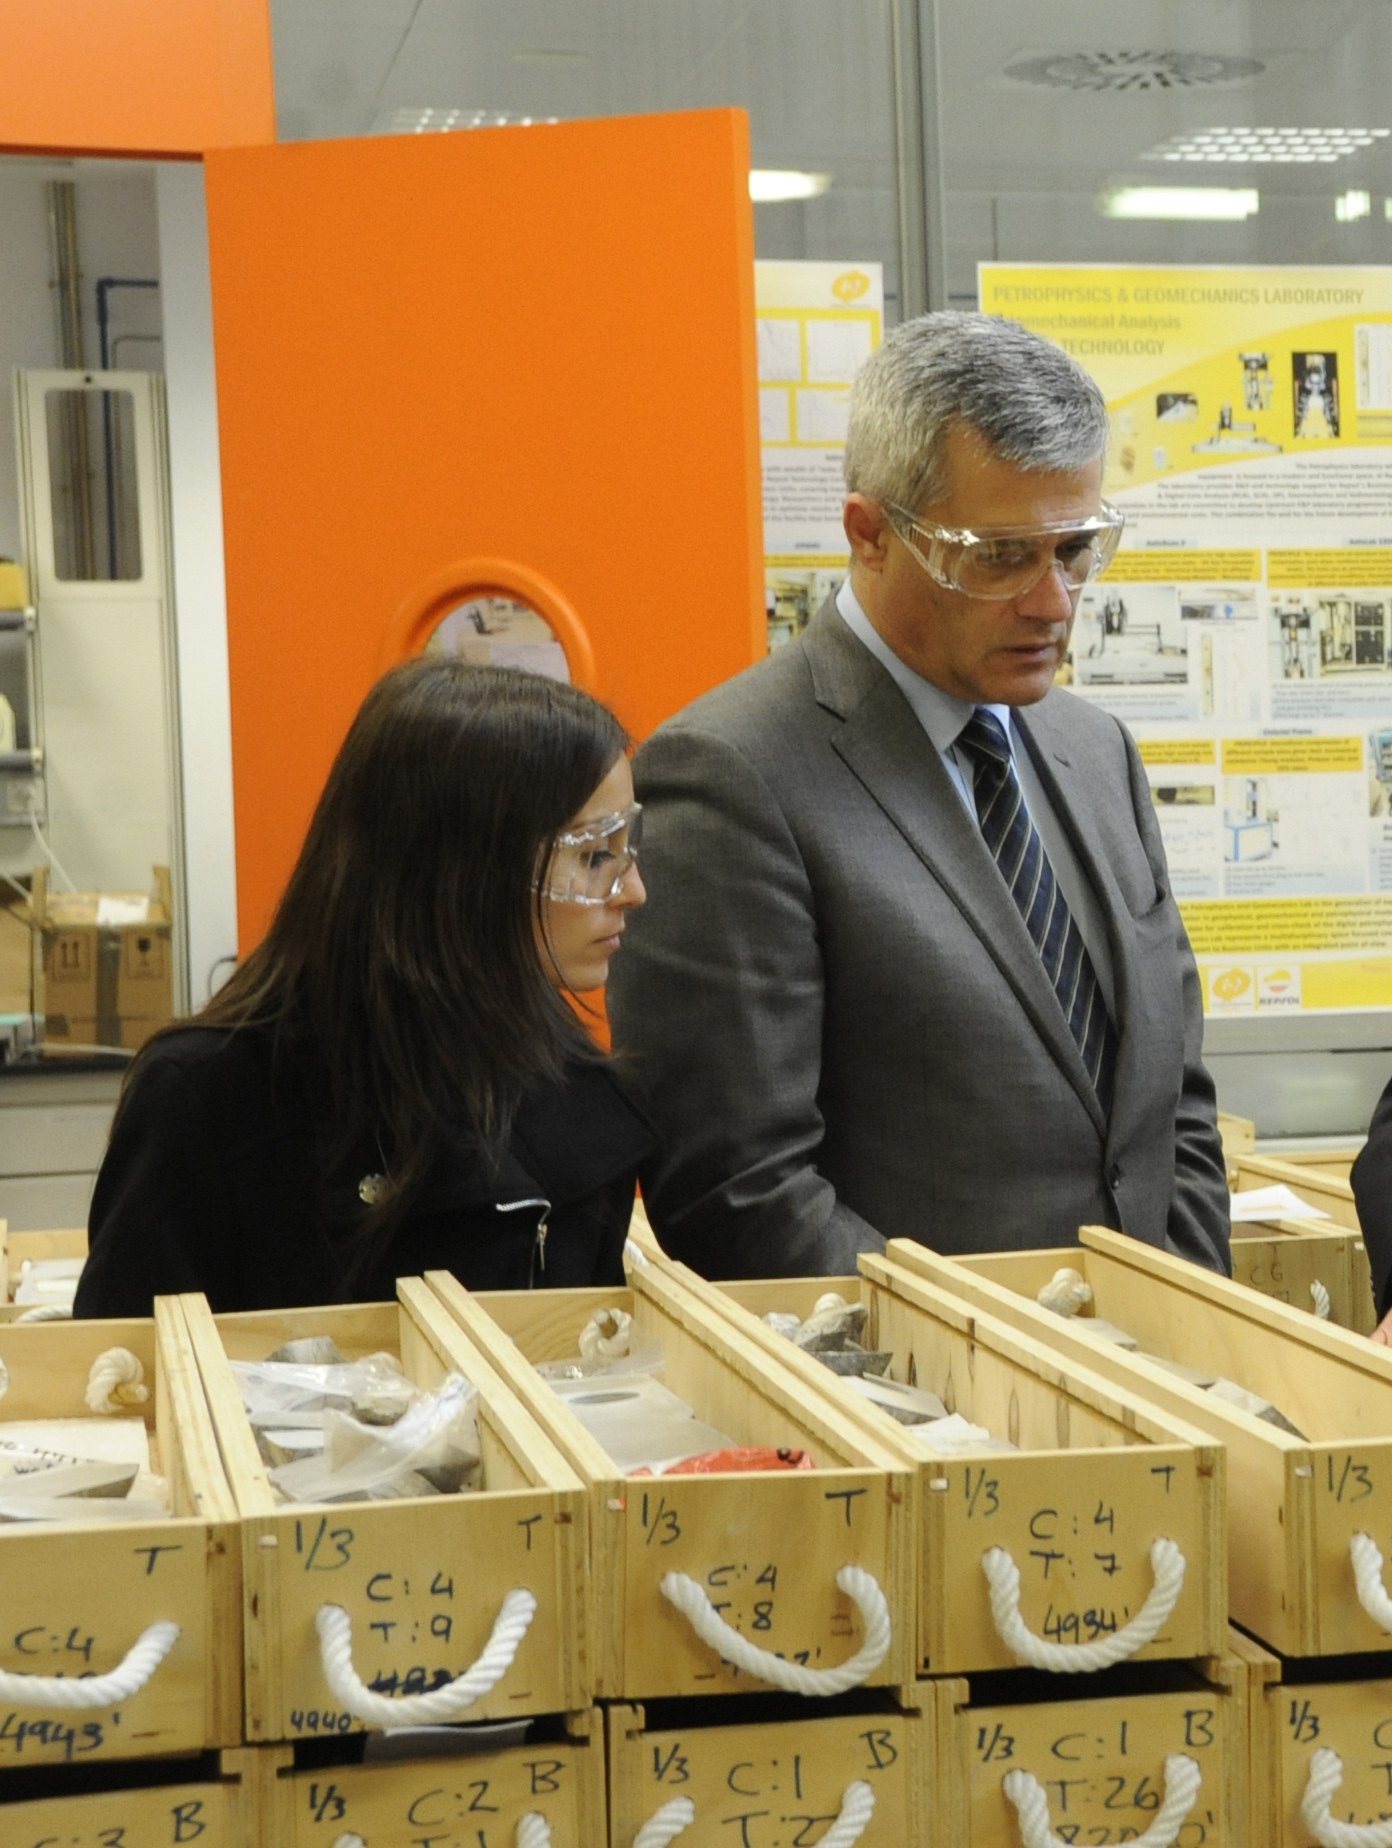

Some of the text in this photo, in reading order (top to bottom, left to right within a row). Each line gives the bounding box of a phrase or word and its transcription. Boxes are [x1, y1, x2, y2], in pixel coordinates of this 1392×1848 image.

[994, 286, 1364, 305] PETROPHYSICS & GEOMECHANICS LABORATORY
[996, 313, 1181, 331] mechanical Analysis
[1062, 339, 1164, 356] TECHNOLOGY
[964, 1467, 1000, 1518] 1/3
[1151, 1465, 1176, 1494] T
[1327, 1454, 1373, 1502] 1/3
[642, 1492, 681, 1546] 1/3
[825, 1489, 868, 1527] T
[295, 1516, 355, 1571] 1/3
[516, 1514, 543, 1551] T
[133, 1544, 183, 1576] T
[1184, 1708, 1214, 1748] B
[1289, 1700, 1320, 1743] 1/3
[859, 1729, 898, 1770] B
[976, 1723, 1015, 1763] 1/3
[521, 1759, 566, 1795] B
[653, 1743, 690, 1784] 1/3
[172, 1801, 207, 1843] B
[308, 1782, 347, 1823] 1/3
